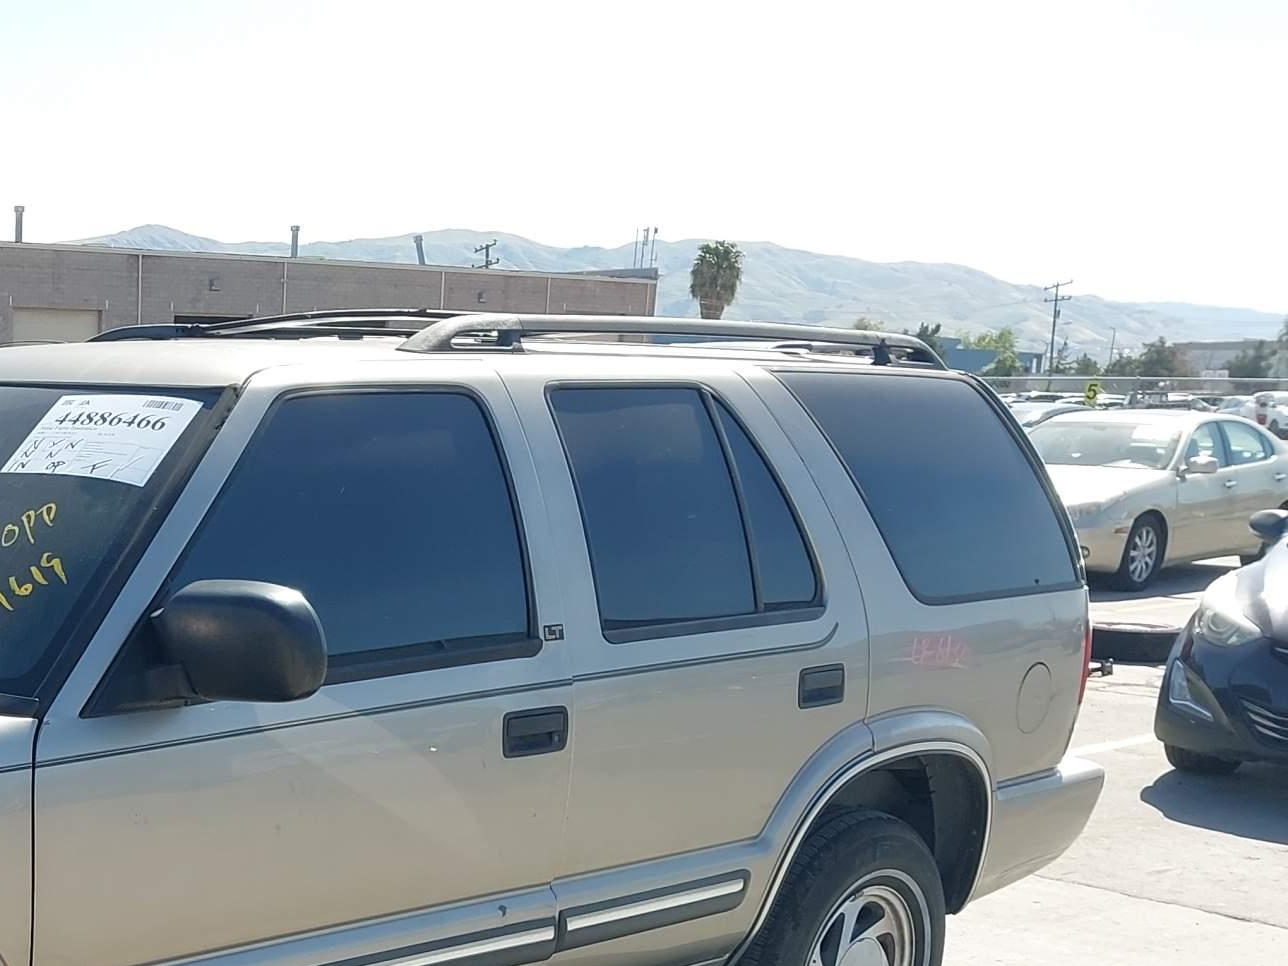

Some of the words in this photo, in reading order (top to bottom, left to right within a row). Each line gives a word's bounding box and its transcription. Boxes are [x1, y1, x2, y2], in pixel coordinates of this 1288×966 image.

[1086, 383, 1098, 400] 5
[55, 411, 170, 431] 44886466
[545, 626, 563, 640] LT
